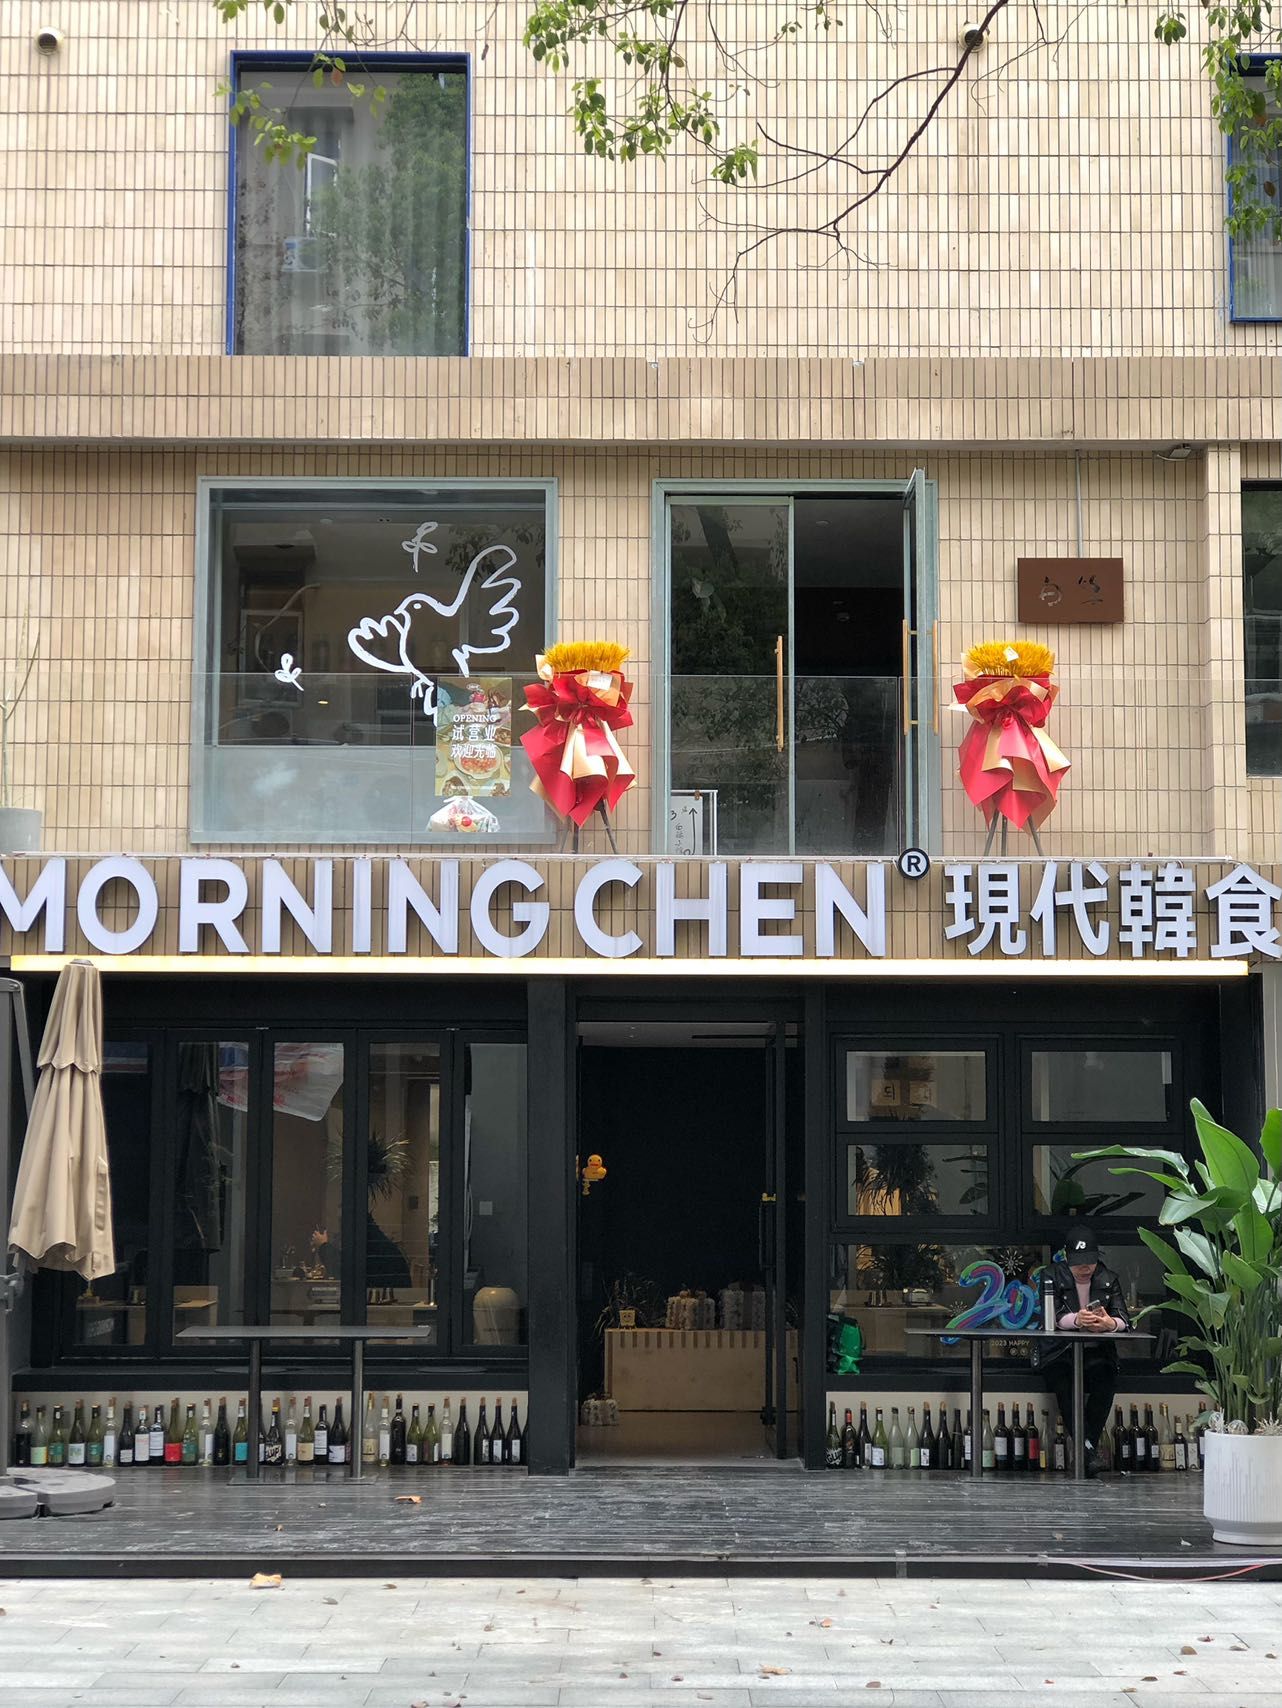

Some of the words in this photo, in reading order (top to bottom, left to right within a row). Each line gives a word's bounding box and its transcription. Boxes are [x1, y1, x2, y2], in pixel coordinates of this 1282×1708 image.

[453, 714, 497, 723] OPENING
[451, 724, 497, 741] 试营业
[944, 861, 1282, 959] 現代韓食
[1008, 1339, 1031, 1347] HAPPY
